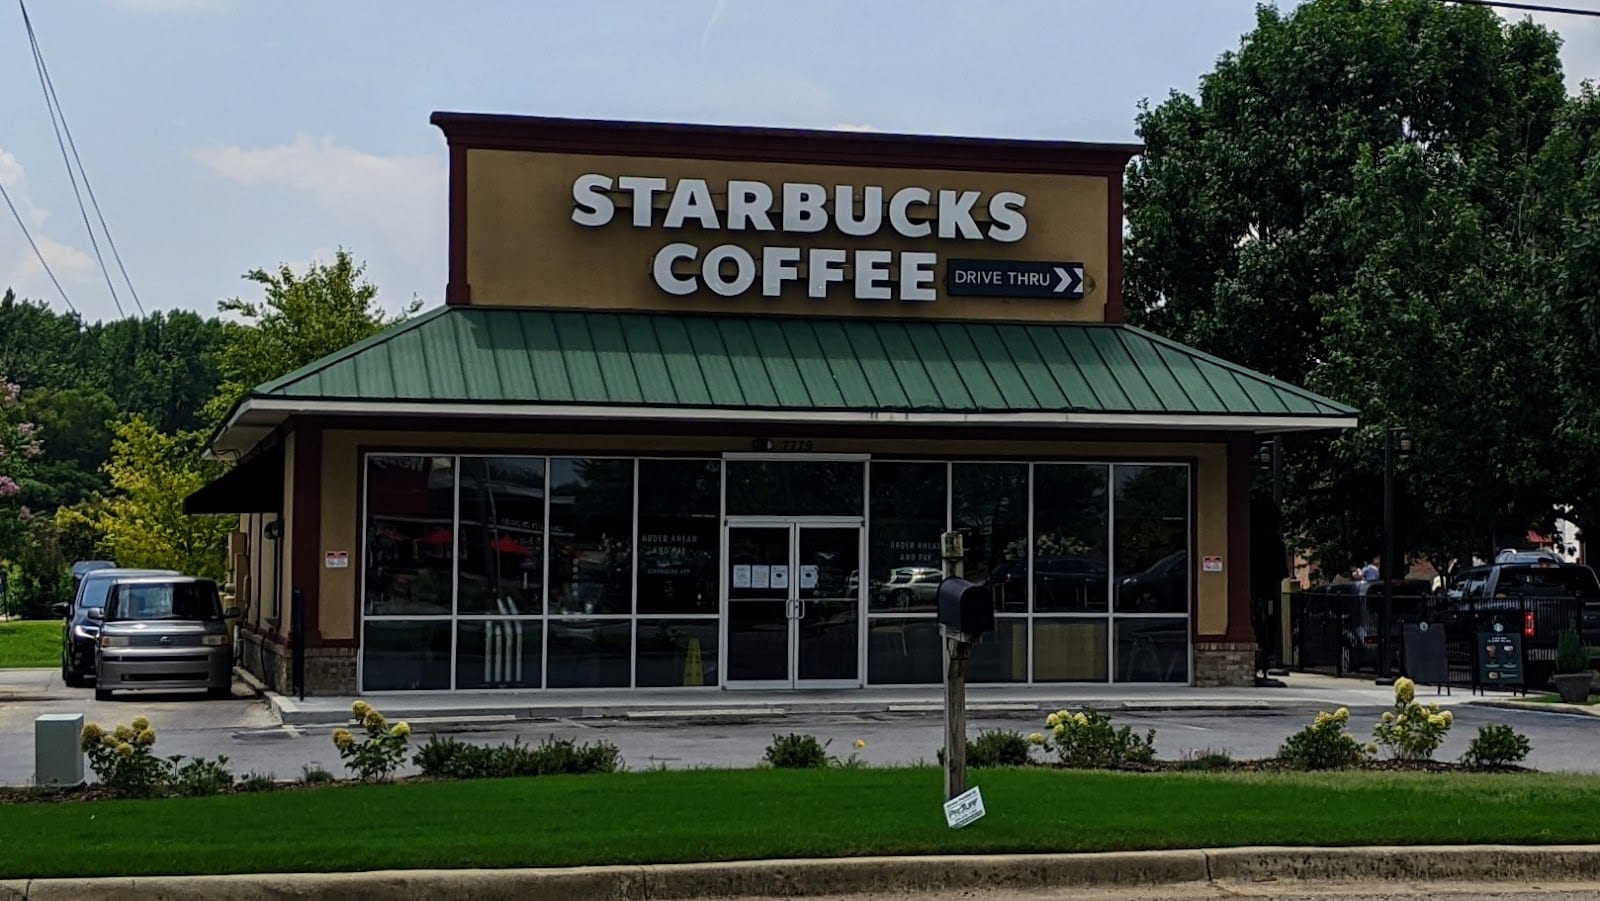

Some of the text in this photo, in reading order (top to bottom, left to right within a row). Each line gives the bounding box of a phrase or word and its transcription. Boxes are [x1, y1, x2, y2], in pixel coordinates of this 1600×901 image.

[571, 173, 1028, 243] STARBUCKS
[652, 242, 938, 301] COFFEE
[954, 269, 1051, 287] DRIVE THRU
[783, 439, 813, 451] 7779
[642, 534, 668, 543] ORDER
[890, 541, 914, 550] ORDER
[900, 553, 932, 561] AND PAY
